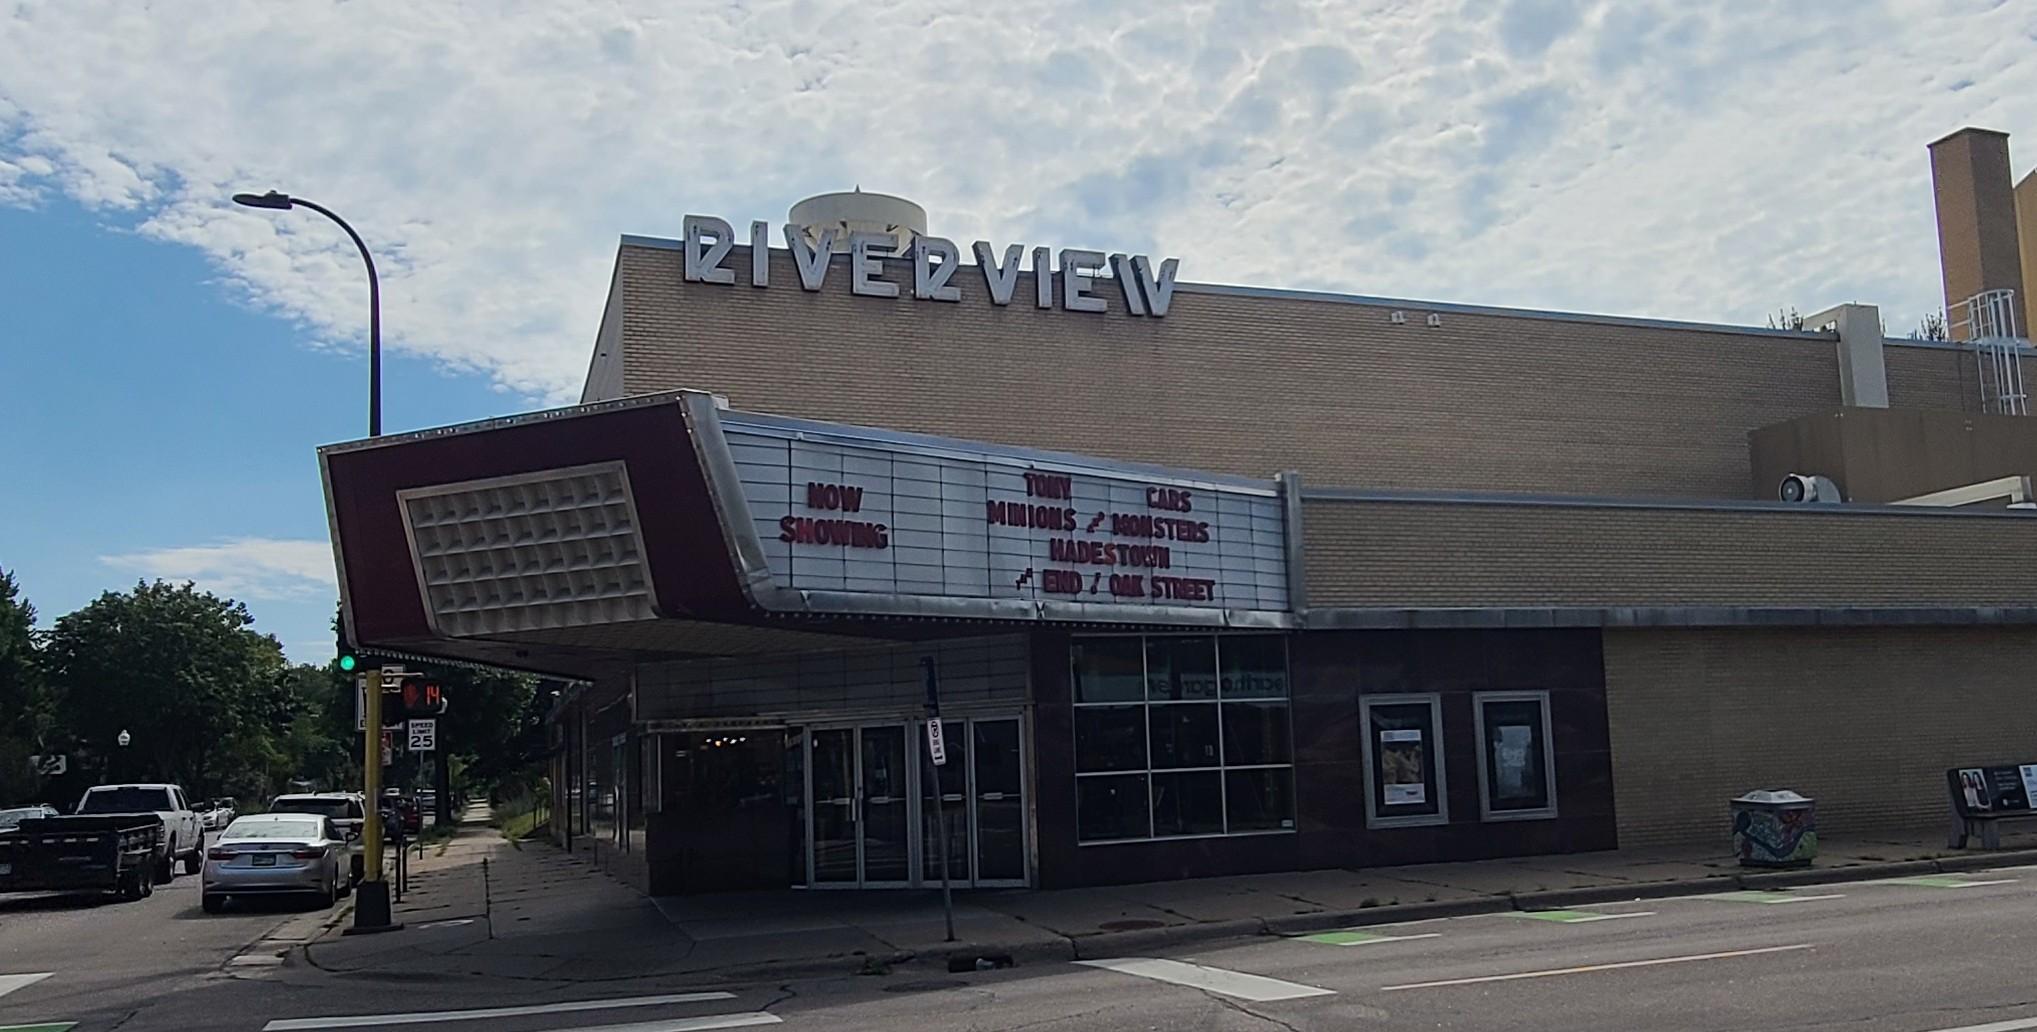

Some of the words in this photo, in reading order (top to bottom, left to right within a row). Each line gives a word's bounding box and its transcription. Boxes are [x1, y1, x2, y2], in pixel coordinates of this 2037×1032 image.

[682, 214, 1181, 317] RIVERVIEW
[807, 482, 863, 512] NOW
[1023, 472, 1073, 500] TONY
[1146, 487, 1192, 513] CARS
[780, 516, 888, 549] SHOWING
[987, 500, 1077, 532] MINIONS
[1112, 513, 1210, 543] MONSTERS
[1050, 538, 1170, 569] HADESTOWN
[1043, 569, 1083, 594] END
[1109, 574, 1145, 597] OAK
[1151, 576, 1216, 601] STREET
[426, 685, 439, 705] 14
[410, 735, 433, 748] 25
